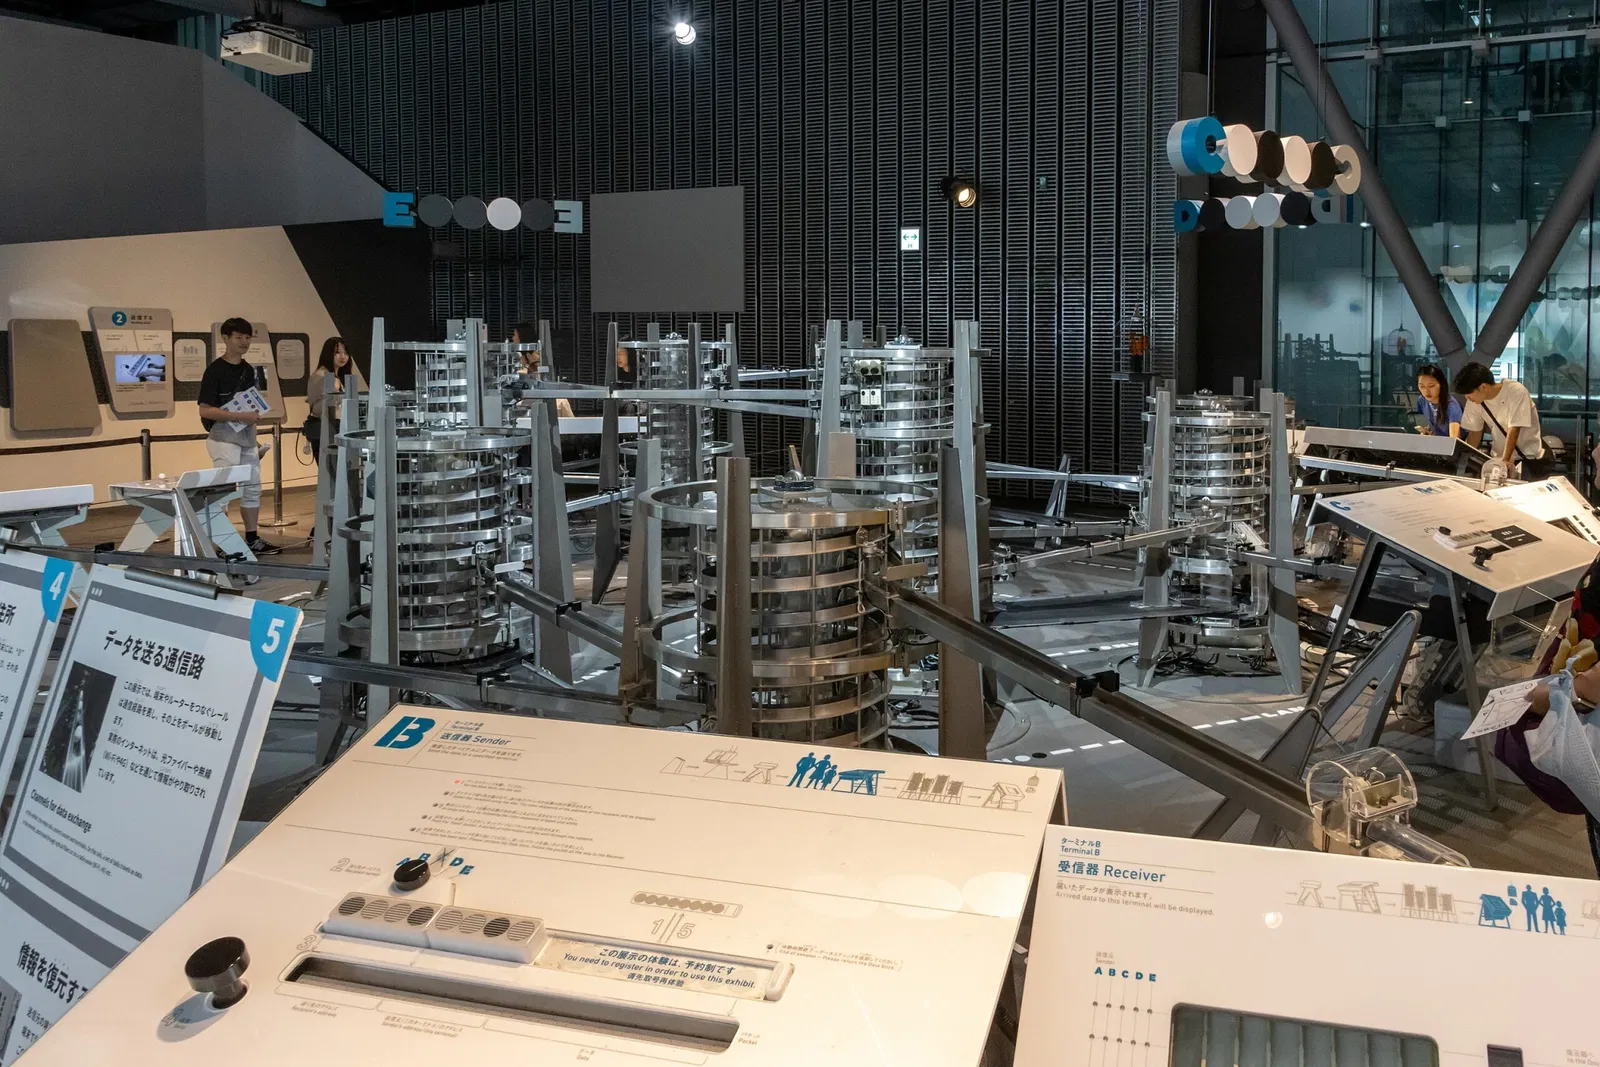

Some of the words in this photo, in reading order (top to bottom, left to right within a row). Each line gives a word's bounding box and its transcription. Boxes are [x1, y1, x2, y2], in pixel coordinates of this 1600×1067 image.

[383, 192, 416, 228] E
[116, 314, 123, 323] 2
[49, 572, 65, 600] 4
[261, 618, 285, 654] 5
[104, 630, 205, 680] データを送る通信路
[374, 716, 436, 749] B
[472, 735, 512, 746] Sender
[56, 805, 68, 819] data
[67, 812, 92, 833] exchange
[1061, 838, 1101, 847] ターミナルB
[1061, 845, 1092, 855] Terminal
[330, 858, 350, 872] 2
[449, 857, 464, 867] D
[459, 864, 475, 876] E
[1058, 860, 1099, 875] 受信器
[1104, 864, 1166, 882] Receiver
[1107, 896, 1120, 904] this
[1122, 899, 1152, 908] terminal
[1178, 905, 1214, 916] displayed.
[651, 919, 664, 934] 1
[677, 922, 696, 939] 5
[296, 934, 317, 950] 3
[563, 953, 578, 961] You
[579, 955, 600, 965] need
[610, 960, 644, 972] register
[645, 964, 653, 972] in
[654, 966, 678, 976] order
[707, 974, 723, 983] this
[725, 977, 756, 988] exhibit.
[599, 948, 736, 974] この展示の体験は、予約制です
[1094, 966, 1102, 975] A
[1109, 968, 1116, 976] B
[1121, 970, 1129, 978] C
[1136, 971, 1143, 980] D
[1149, 973, 1156, 982] E
